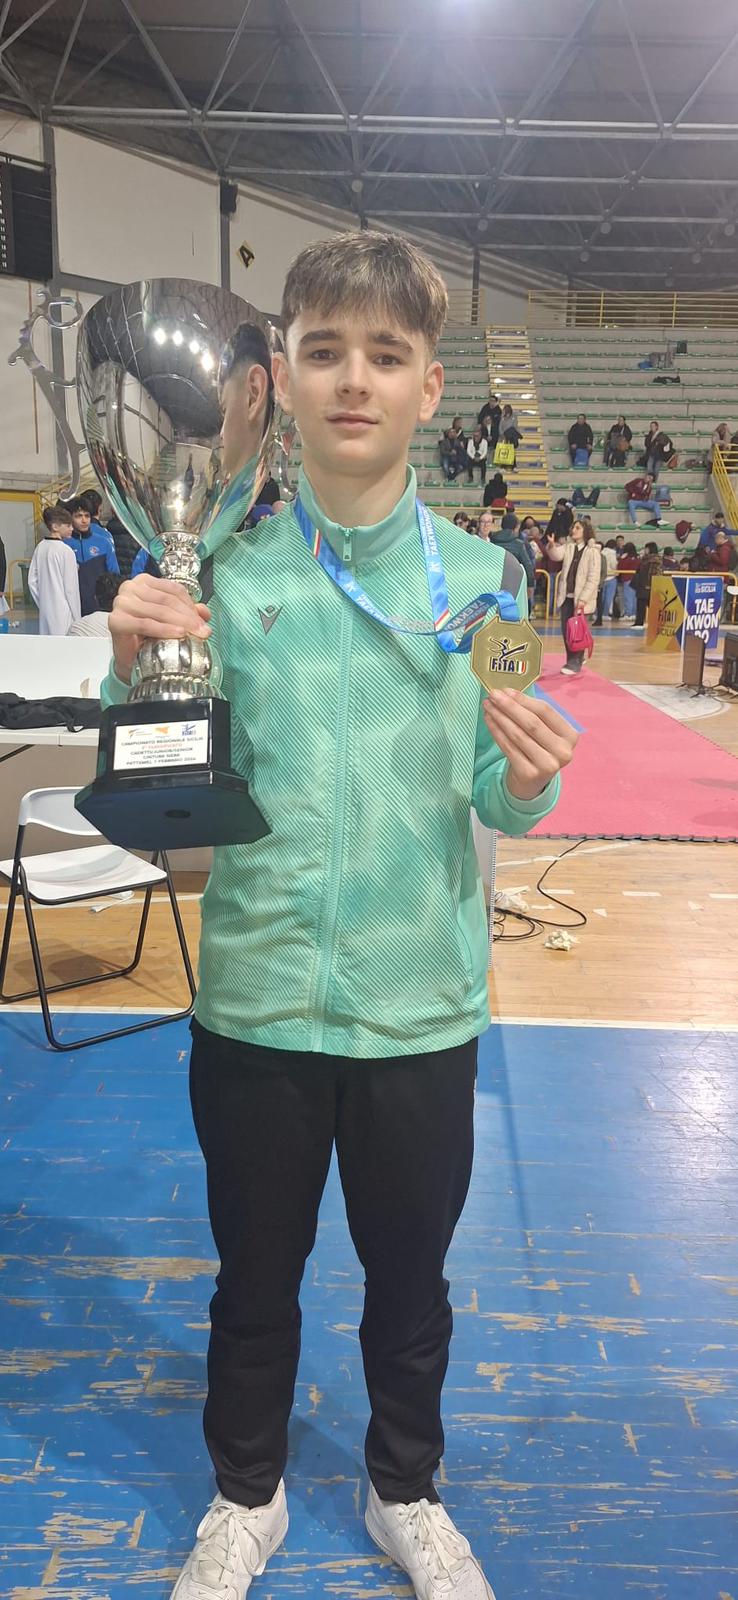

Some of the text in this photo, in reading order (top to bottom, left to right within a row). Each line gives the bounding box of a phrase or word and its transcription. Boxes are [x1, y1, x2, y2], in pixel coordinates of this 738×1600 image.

[239, 244, 255, 268] A
[695, 598, 715, 614] TAE
[686, 614, 718, 630] KWON
[492, 658, 515, 672] FITA
